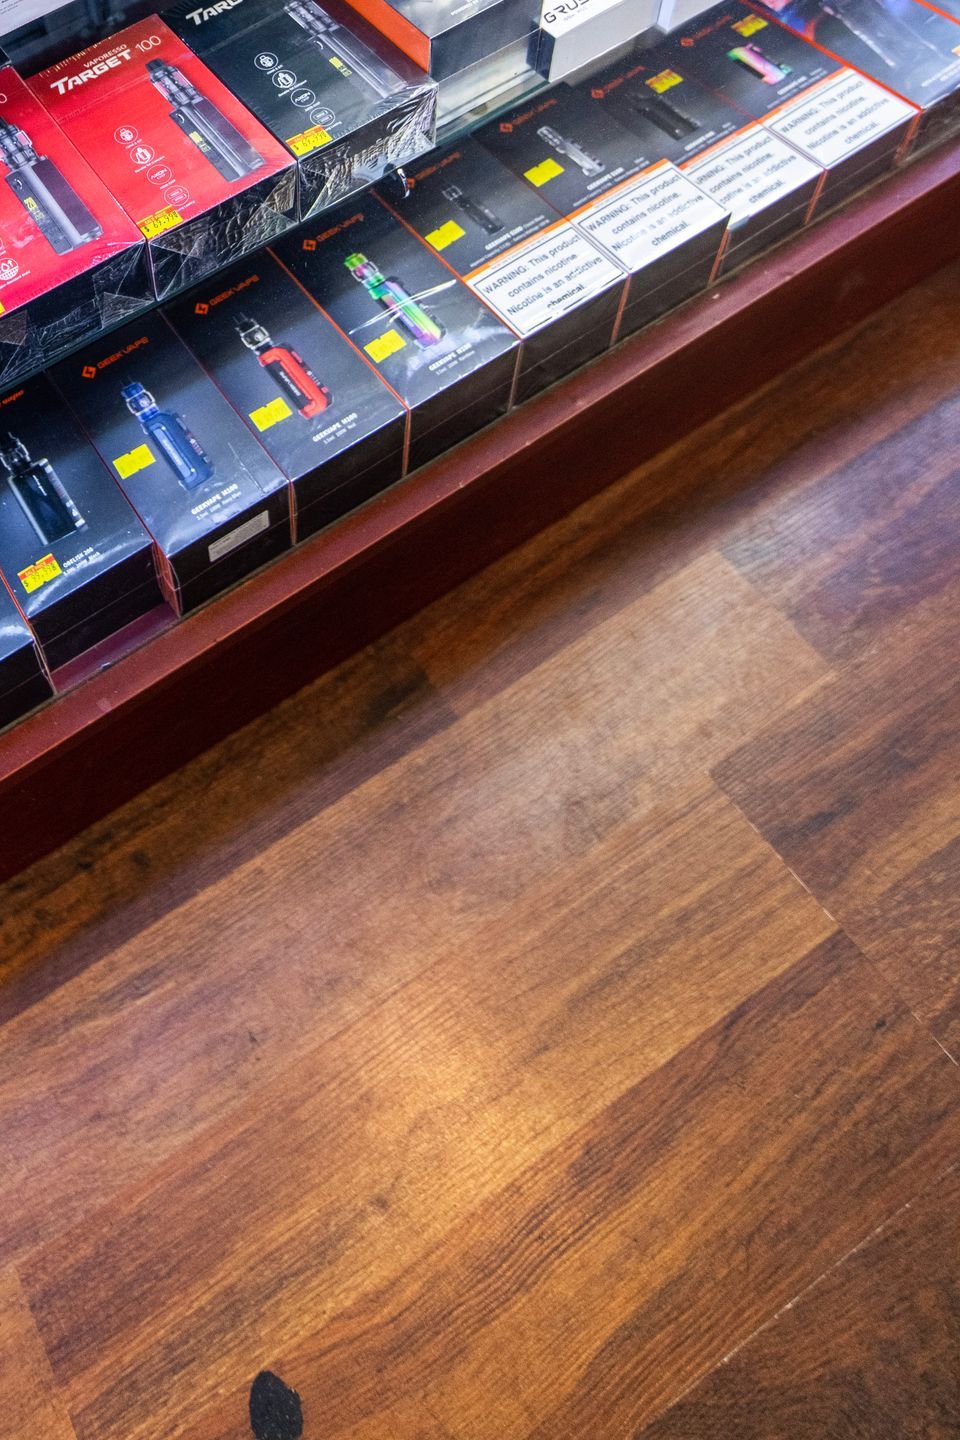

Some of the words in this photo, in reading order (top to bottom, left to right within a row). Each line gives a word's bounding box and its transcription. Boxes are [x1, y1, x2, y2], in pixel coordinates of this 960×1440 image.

[49, 48, 132, 96] TARGET
[135, 35, 161, 53] 100
[83, 44, 127, 69] VAPORESSO
[709, 167, 745, 194] contains
[586, 198, 631, 233] WARNING:
[631, 186, 649, 204] This
[650, 173, 682, 201] product
[611, 209, 646, 235] contains
[483, 264, 530, 295] WARNING:
[529, 252, 546, 268] This
[549, 234, 581, 259] product
[507, 291, 544, 316] Nicotine
[554, 278, 567, 289] an
[566, 256, 603, 280] addictive
[508, 274, 544, 298] contains
